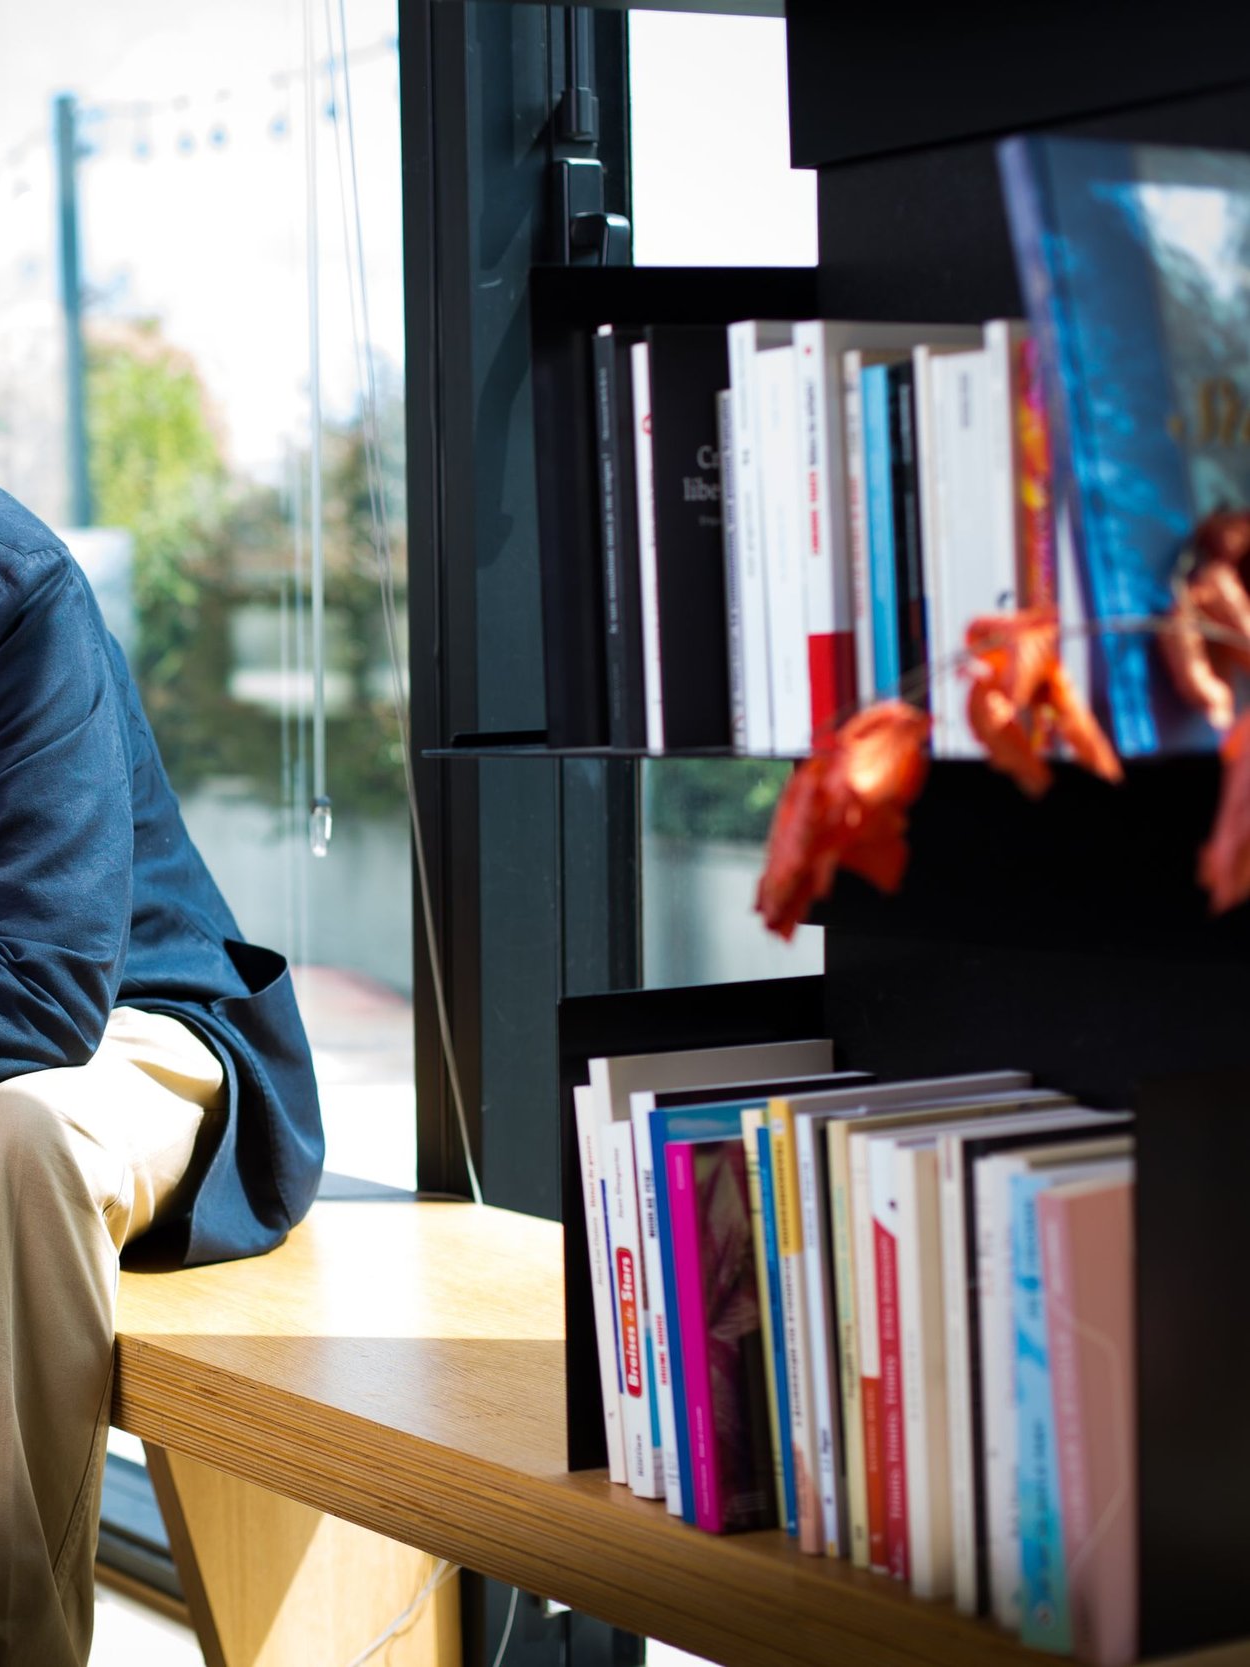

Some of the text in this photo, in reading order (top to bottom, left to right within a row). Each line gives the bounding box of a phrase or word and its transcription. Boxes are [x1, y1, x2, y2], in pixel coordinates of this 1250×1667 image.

[620, 1257, 639, 1387] Braises de Stars
